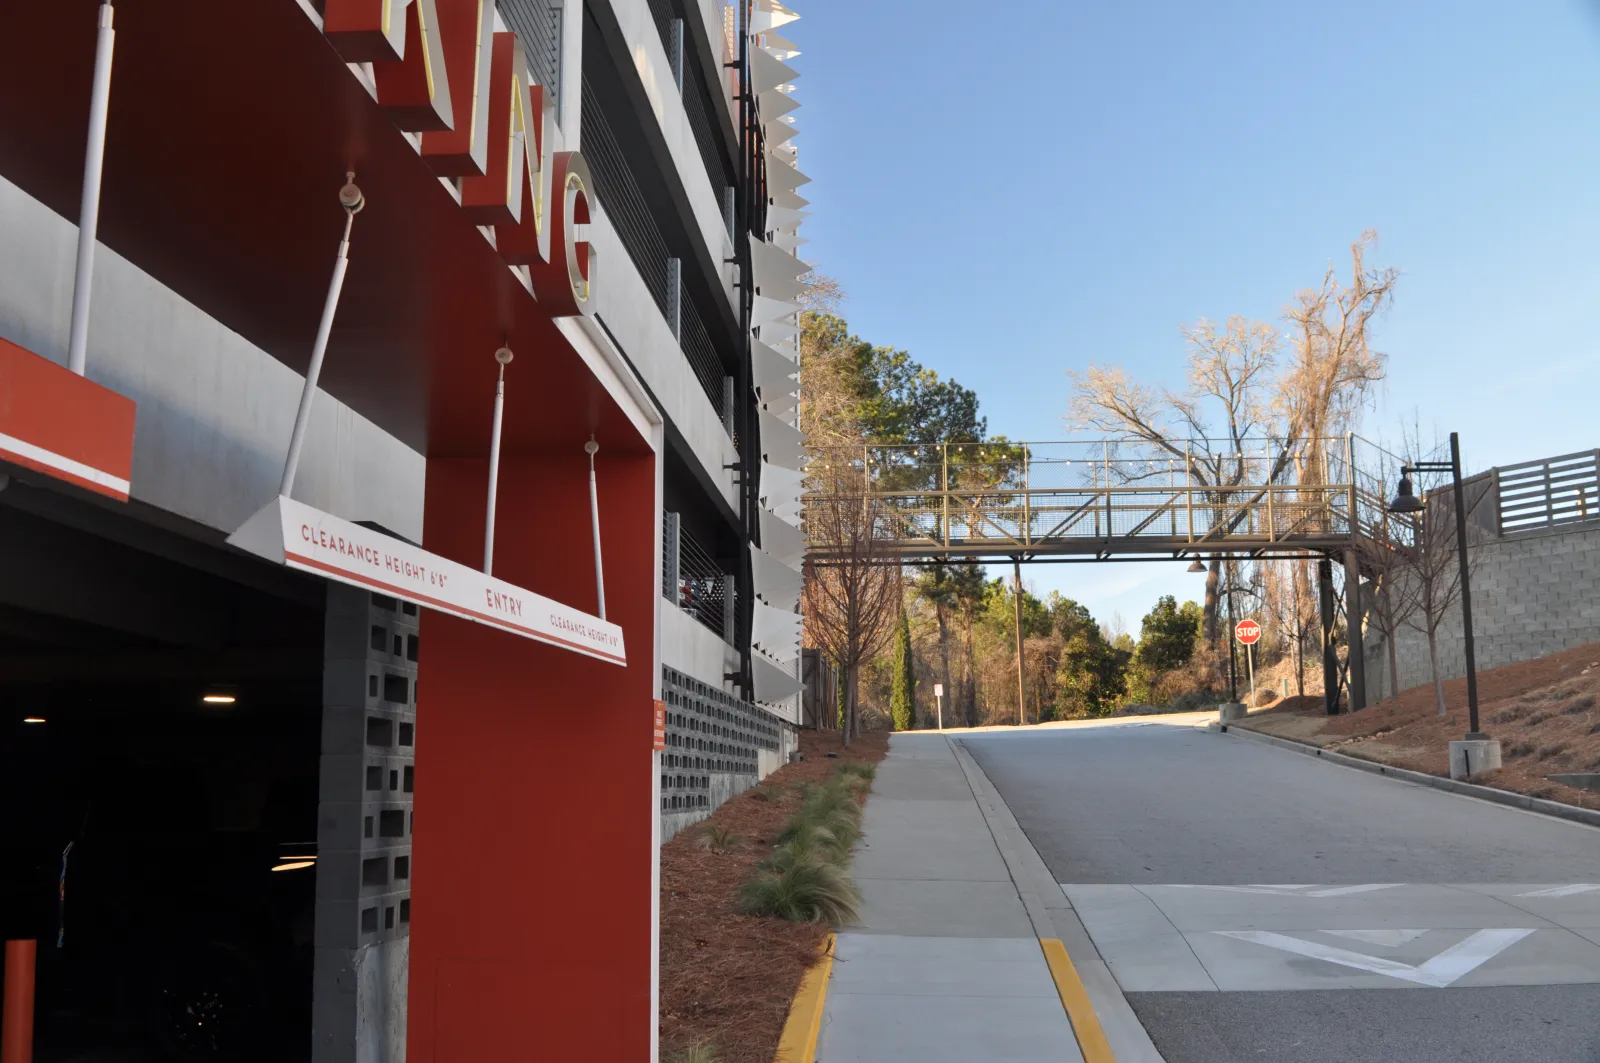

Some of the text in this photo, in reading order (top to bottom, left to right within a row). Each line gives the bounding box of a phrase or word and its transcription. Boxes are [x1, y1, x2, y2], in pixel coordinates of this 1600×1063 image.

[301, 524, 448, 588] CLEARANCE HEIGHT 6'8"
[486, 588, 522, 617] ENTRY
[549, 614, 586, 637] CLEARANCE
[588, 629, 608, 643] HEIGHT
[1237, 626, 1259, 637] STOP
